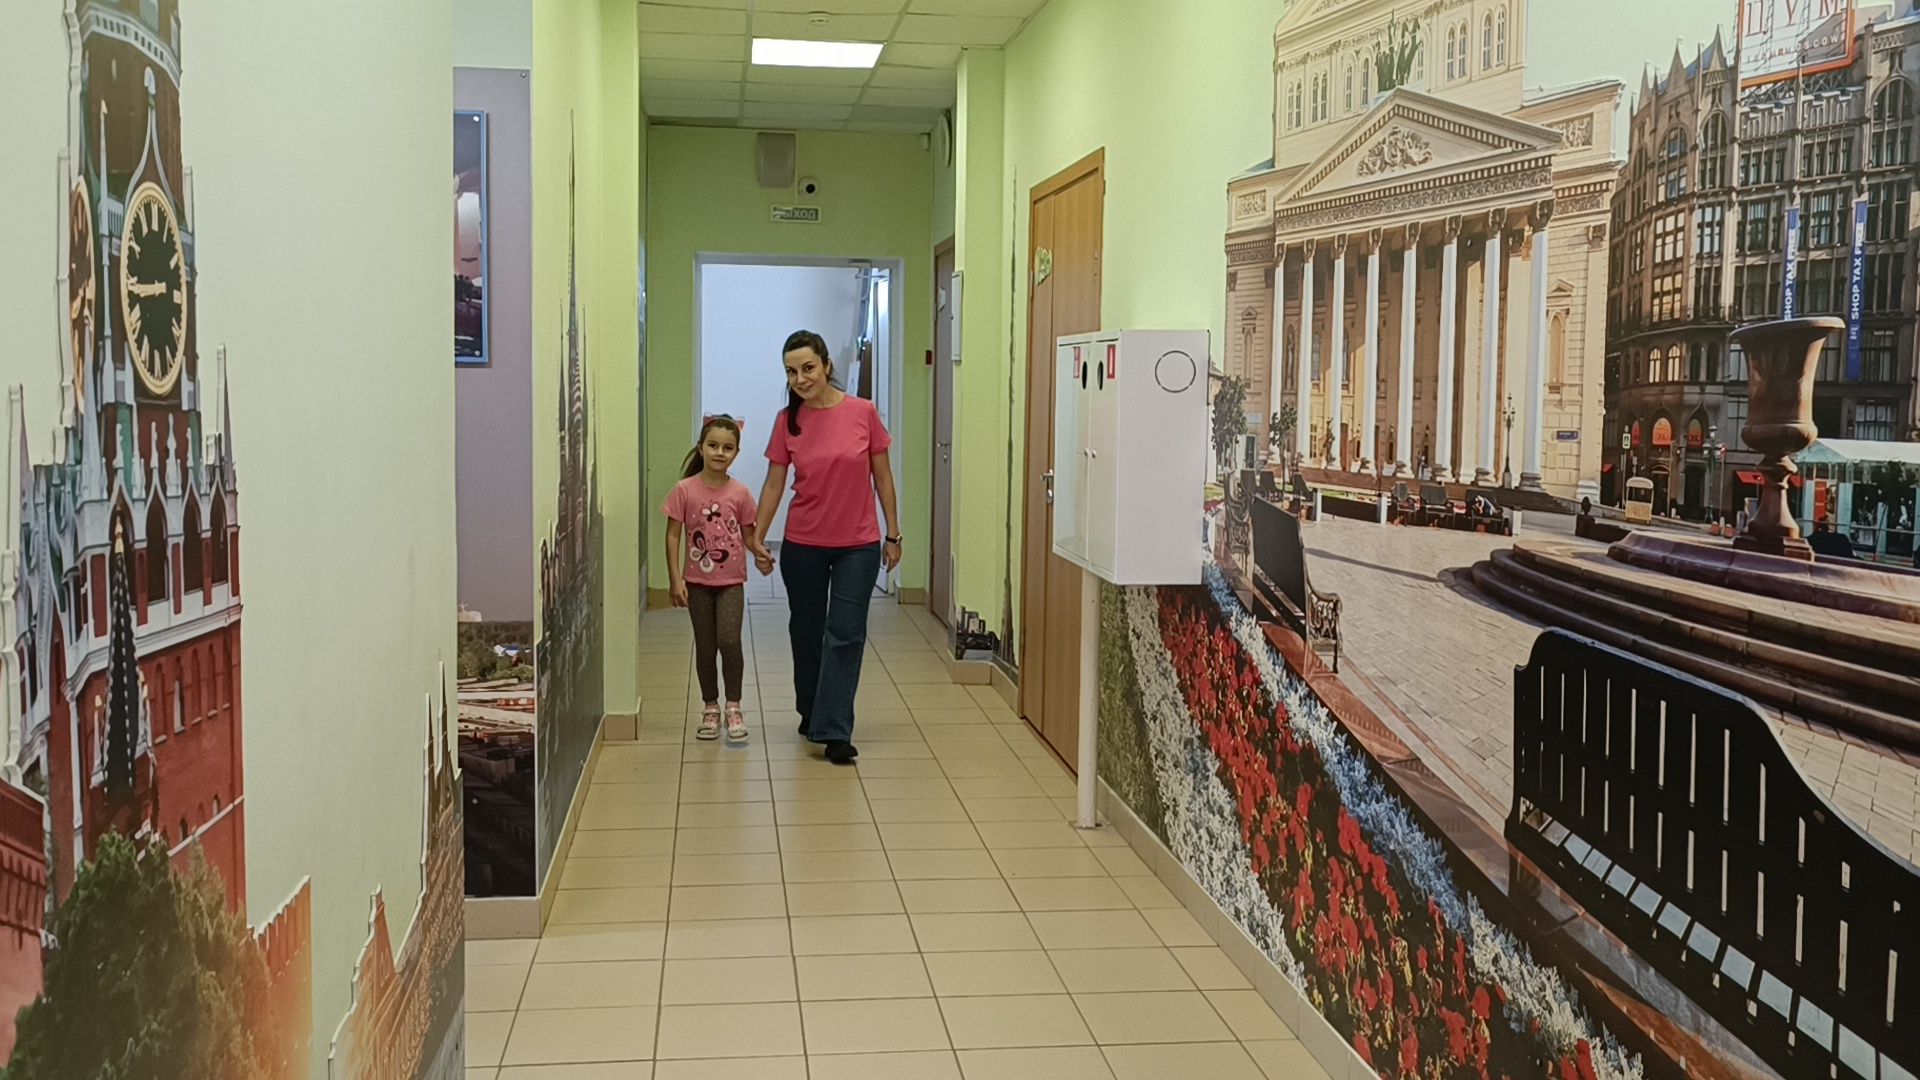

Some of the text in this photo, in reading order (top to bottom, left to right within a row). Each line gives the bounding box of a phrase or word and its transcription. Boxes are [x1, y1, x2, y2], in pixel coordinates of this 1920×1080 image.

[775, 209, 816, 219] ЫХОД
[1786, 262, 1794, 286] TAX
[1853, 258, 1861, 283] TAX
[1784, 288, 1793, 320] SHOP
[1851, 284, 1860, 319] SHOP
